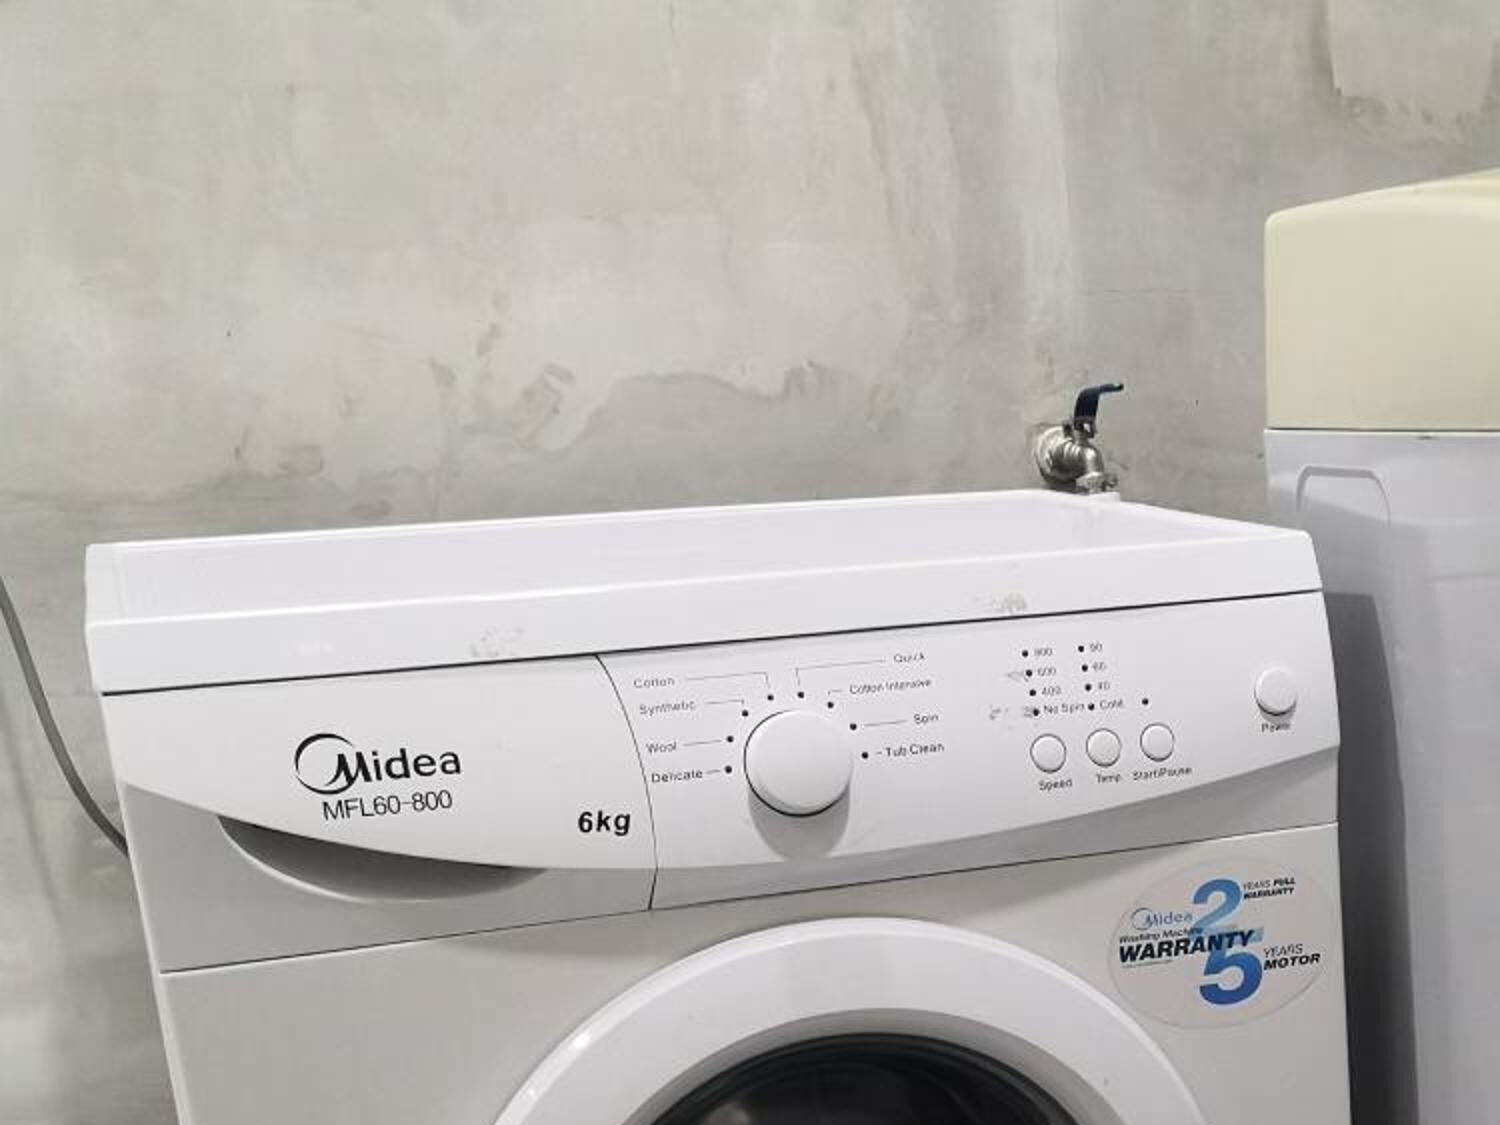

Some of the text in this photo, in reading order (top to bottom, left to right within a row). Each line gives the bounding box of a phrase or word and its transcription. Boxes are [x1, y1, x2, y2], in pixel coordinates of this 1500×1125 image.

[639, 700, 697, 717] Synthetic
[913, 713, 939, 725] Spin
[645, 741, 678, 754] Wool
[885, 743, 945, 757] Tub Clean
[306, 737, 462, 791] Midea
[651, 768, 704, 784] Delicate
[1038, 778, 1073, 792] Speed
[322, 789, 453, 821] MFL60-800
[577, 810, 632, 837] 6kg
[1190, 878, 1243, 938] 2
[1136, 909, 1193, 929] Midea
[1119, 929, 1255, 963] WARRANTY
[1264, 943, 1304, 957] YEARS
[1200, 928, 1264, 1006] 5
[1264, 952, 1321, 970] MOTOR
